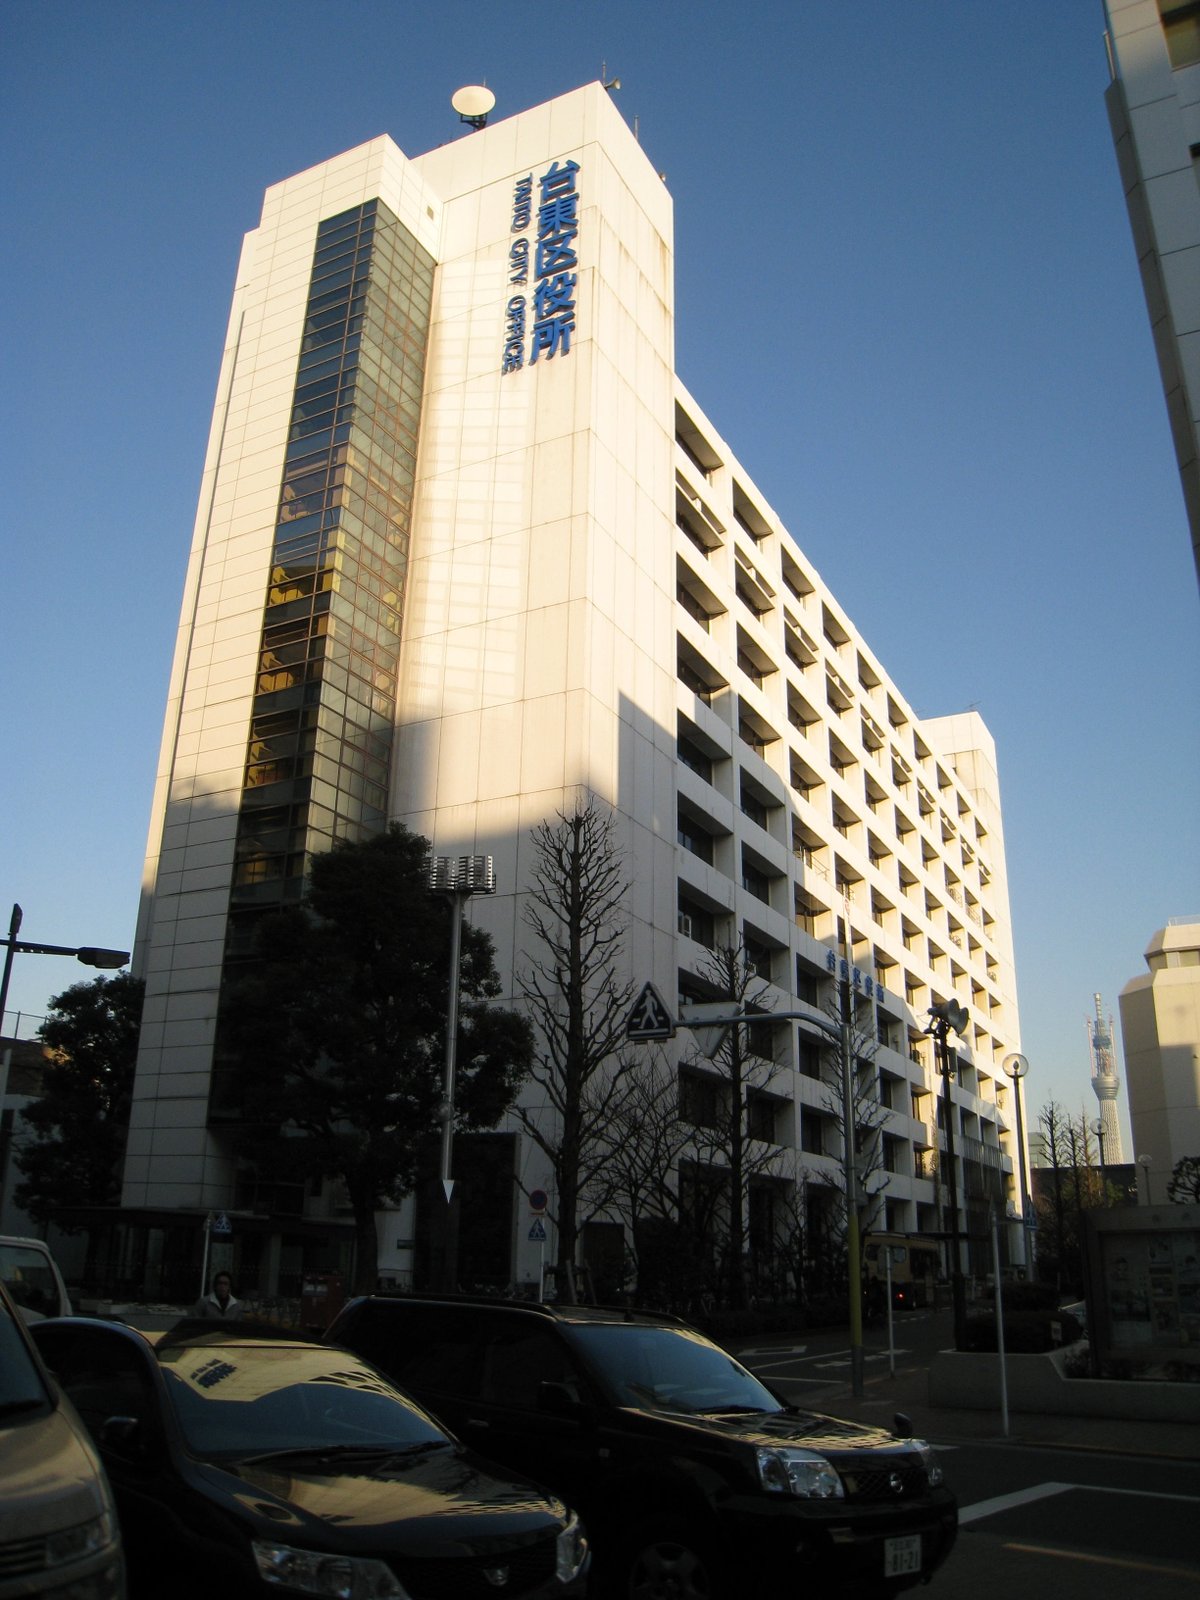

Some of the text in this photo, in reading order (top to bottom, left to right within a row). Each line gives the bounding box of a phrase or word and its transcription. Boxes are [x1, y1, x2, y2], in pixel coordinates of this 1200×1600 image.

[501, 172, 533, 376] TAITO CITY OFFICE
[529, 159, 581, 366] 台東区役所
